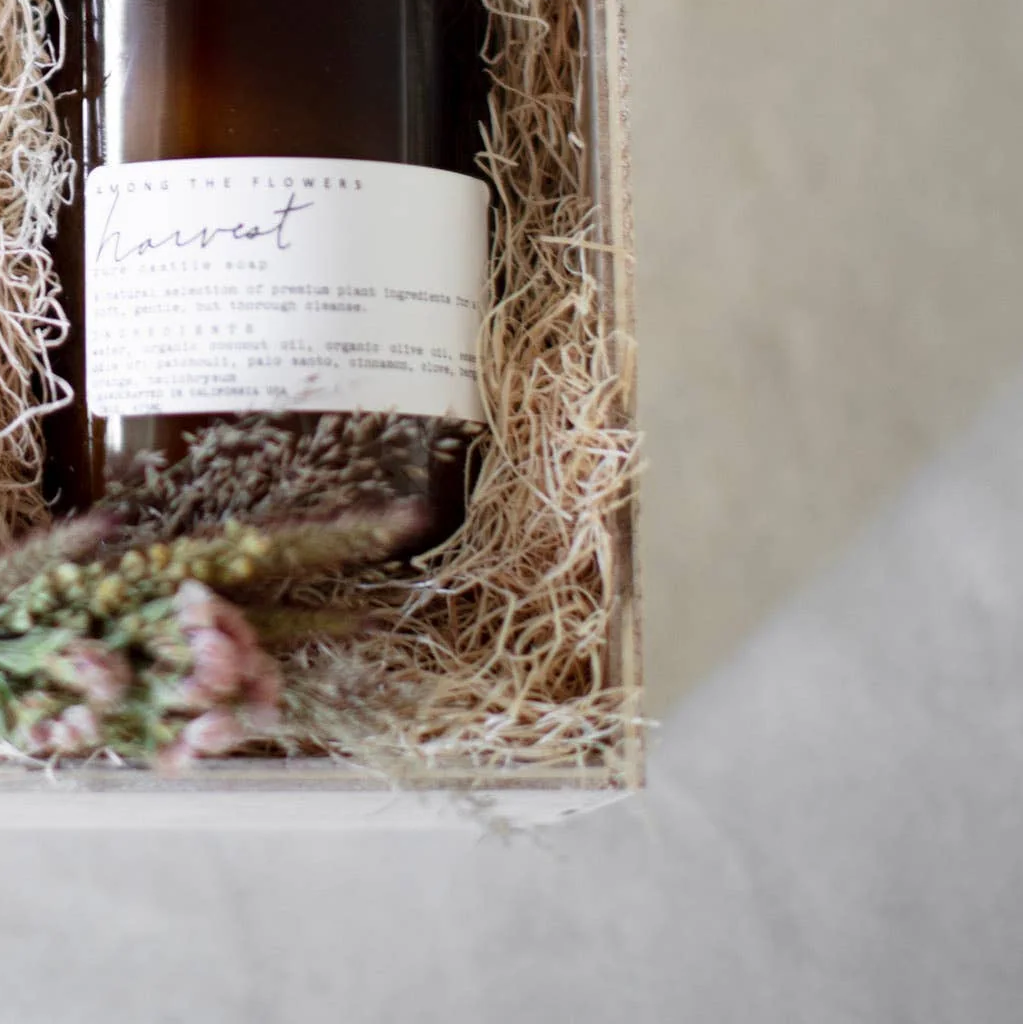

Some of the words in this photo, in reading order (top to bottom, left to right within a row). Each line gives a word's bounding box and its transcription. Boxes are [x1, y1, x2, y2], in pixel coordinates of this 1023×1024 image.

[97, 180, 169, 194] AMONG
[190, 177, 231, 189] THE
[252, 176, 363, 190] FLOWERS
[96, 184, 315, 263] harvest
[225, 259, 268, 273] soap
[165, 284, 239, 297] selection
[246, 283, 264, 295] of
[271, 283, 330, 297] premium
[337, 284, 376, 297] plant
[384, 287, 451, 305] ingredients
[195, 301, 221, 313] but
[229, 301, 297, 314] thorough
[305, 301, 367, 314] cleanse.
[325, 340, 380, 355] organic
[389, 342, 424, 355] olive
[247, 355, 282, 369] palo
[292, 355, 340, 369] santo,
